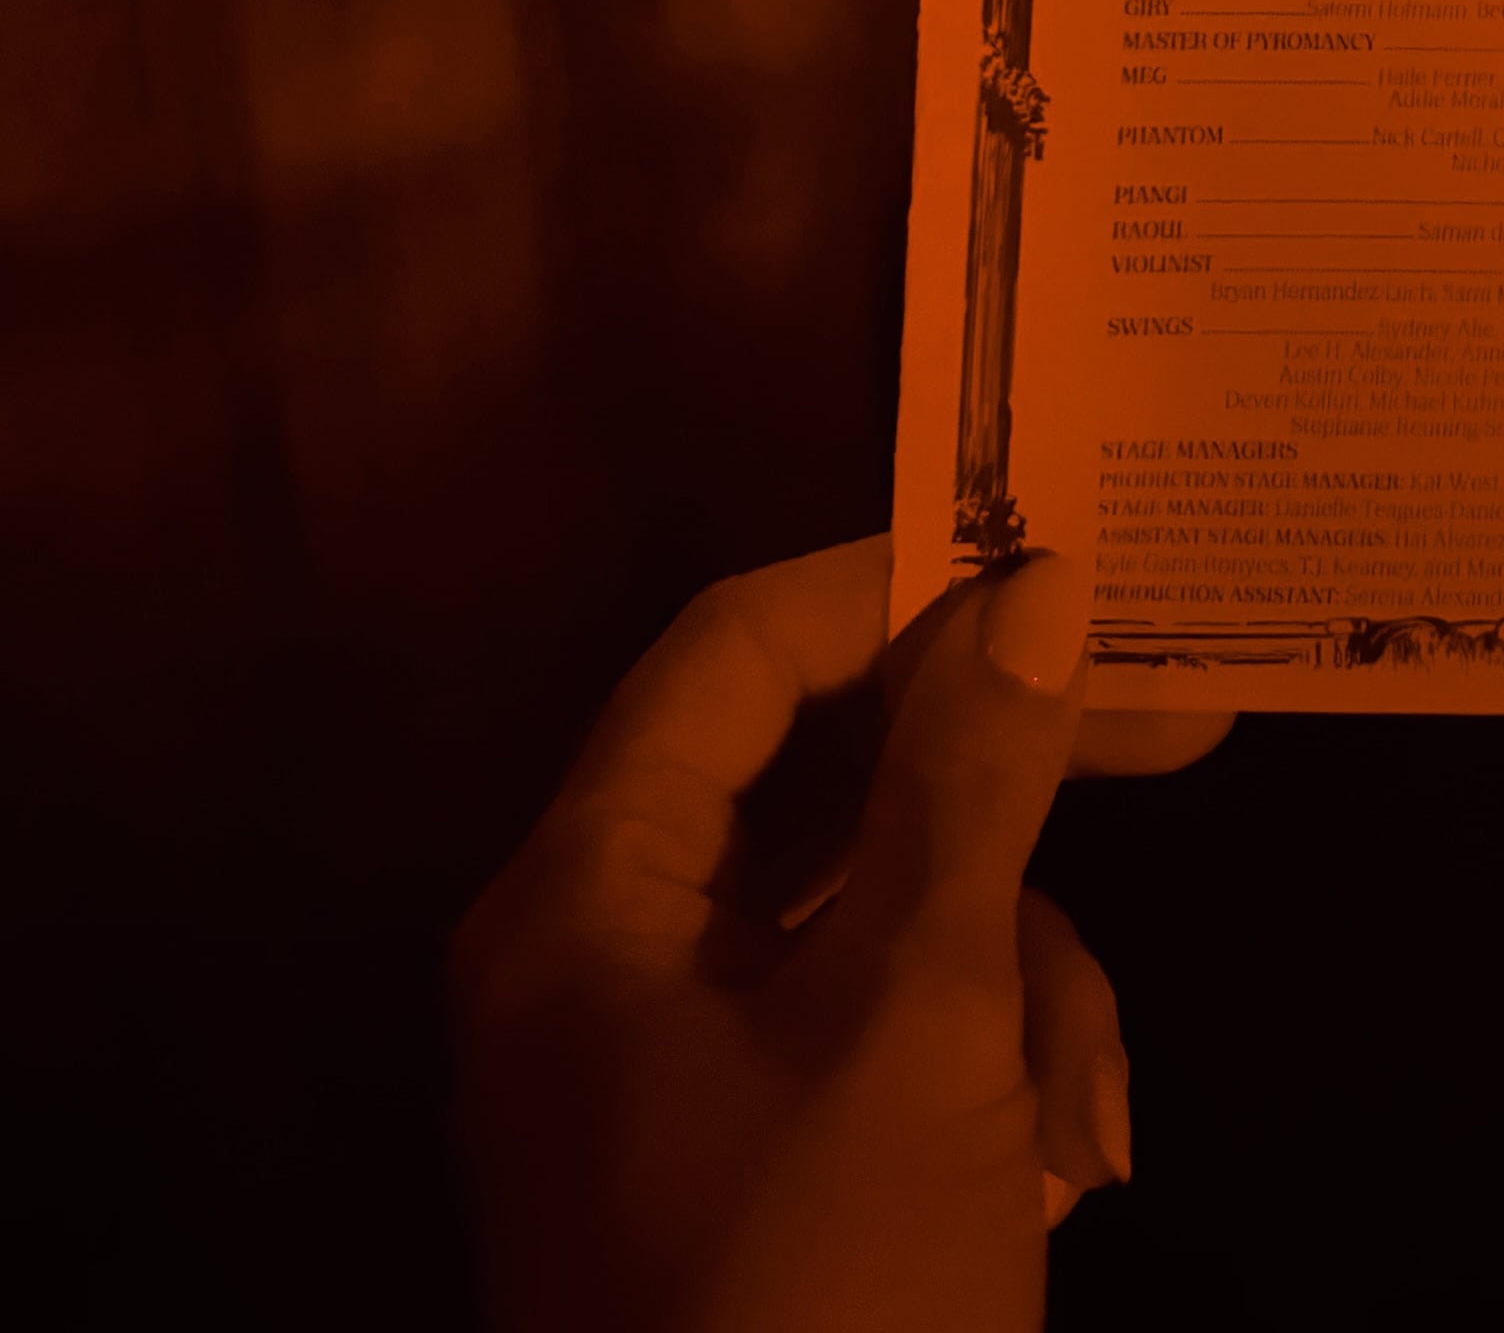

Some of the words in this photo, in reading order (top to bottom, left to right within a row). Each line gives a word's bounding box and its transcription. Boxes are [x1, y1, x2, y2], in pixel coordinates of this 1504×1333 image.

[1123, 32, 1206, 51] MASTER
[1213, 32, 1241, 51] OF
[1247, 33, 1376, 51] PYROMANCY
[1121, 67, 1167, 85] MEG
[1117, 125, 1223, 145] PHANTOM
[1114, 185, 1187, 205] PIANGI
[1112, 220, 1186, 240] RAOUL
[1112, 254, 1214, 274] VIOLINIST
[1210, 281, 1266, 303] Bryan
[1107, 316, 1193, 336] SWINGS
[1280, 365, 1341, 384] Austin
[1101, 440, 1168, 460] STAGE
[1176, 440, 1298, 460] MANAGERS
[1100, 470, 1227, 489] PRODUCTION
[1233, 470, 1300, 490] STAGE
[1303, 471, 1403, 491] MANAGER:
[1098, 499, 1163, 517] STAGE
[1167, 499, 1268, 517] MANAGER:
[1096, 527, 1201, 546] ASSISTANT
[1207, 527, 1273, 546] STAGE
[1094, 584, 1225, 604] PRODUCTION
[1230, 585, 1339, 605] ASSISTANT:
